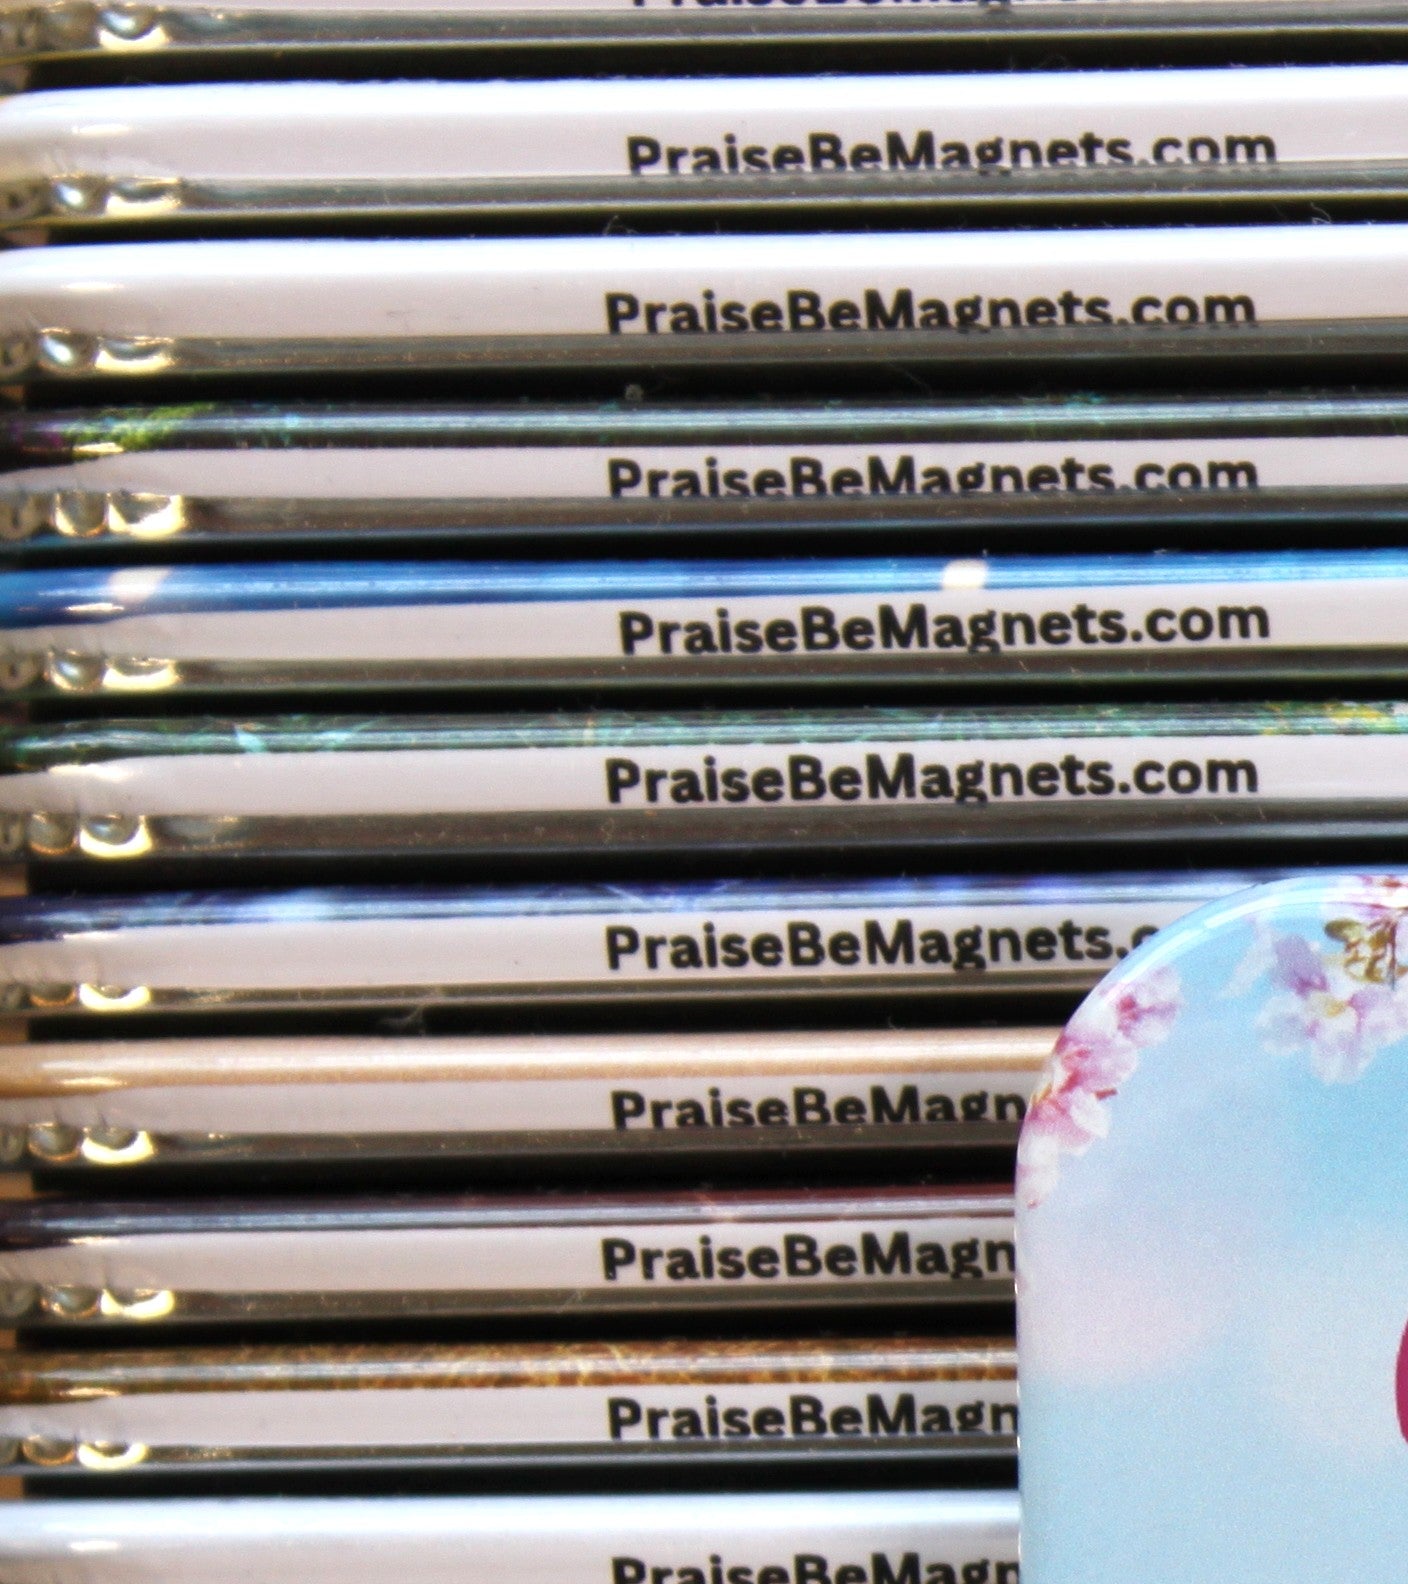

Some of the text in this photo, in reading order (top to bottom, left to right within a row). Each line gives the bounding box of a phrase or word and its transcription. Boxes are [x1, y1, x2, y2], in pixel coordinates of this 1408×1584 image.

[627, 130, 1276, 174] PraiseBeMagnets.com
[605, 289, 1256, 333] PraiseBeMagnets.com
[608, 456, 1259, 499] PraiseBeMagnets.com
[619, 603, 1270, 656] PraiseBeMagnets.com
[605, 753, 1259, 804] PraiseBeMagnets.com
